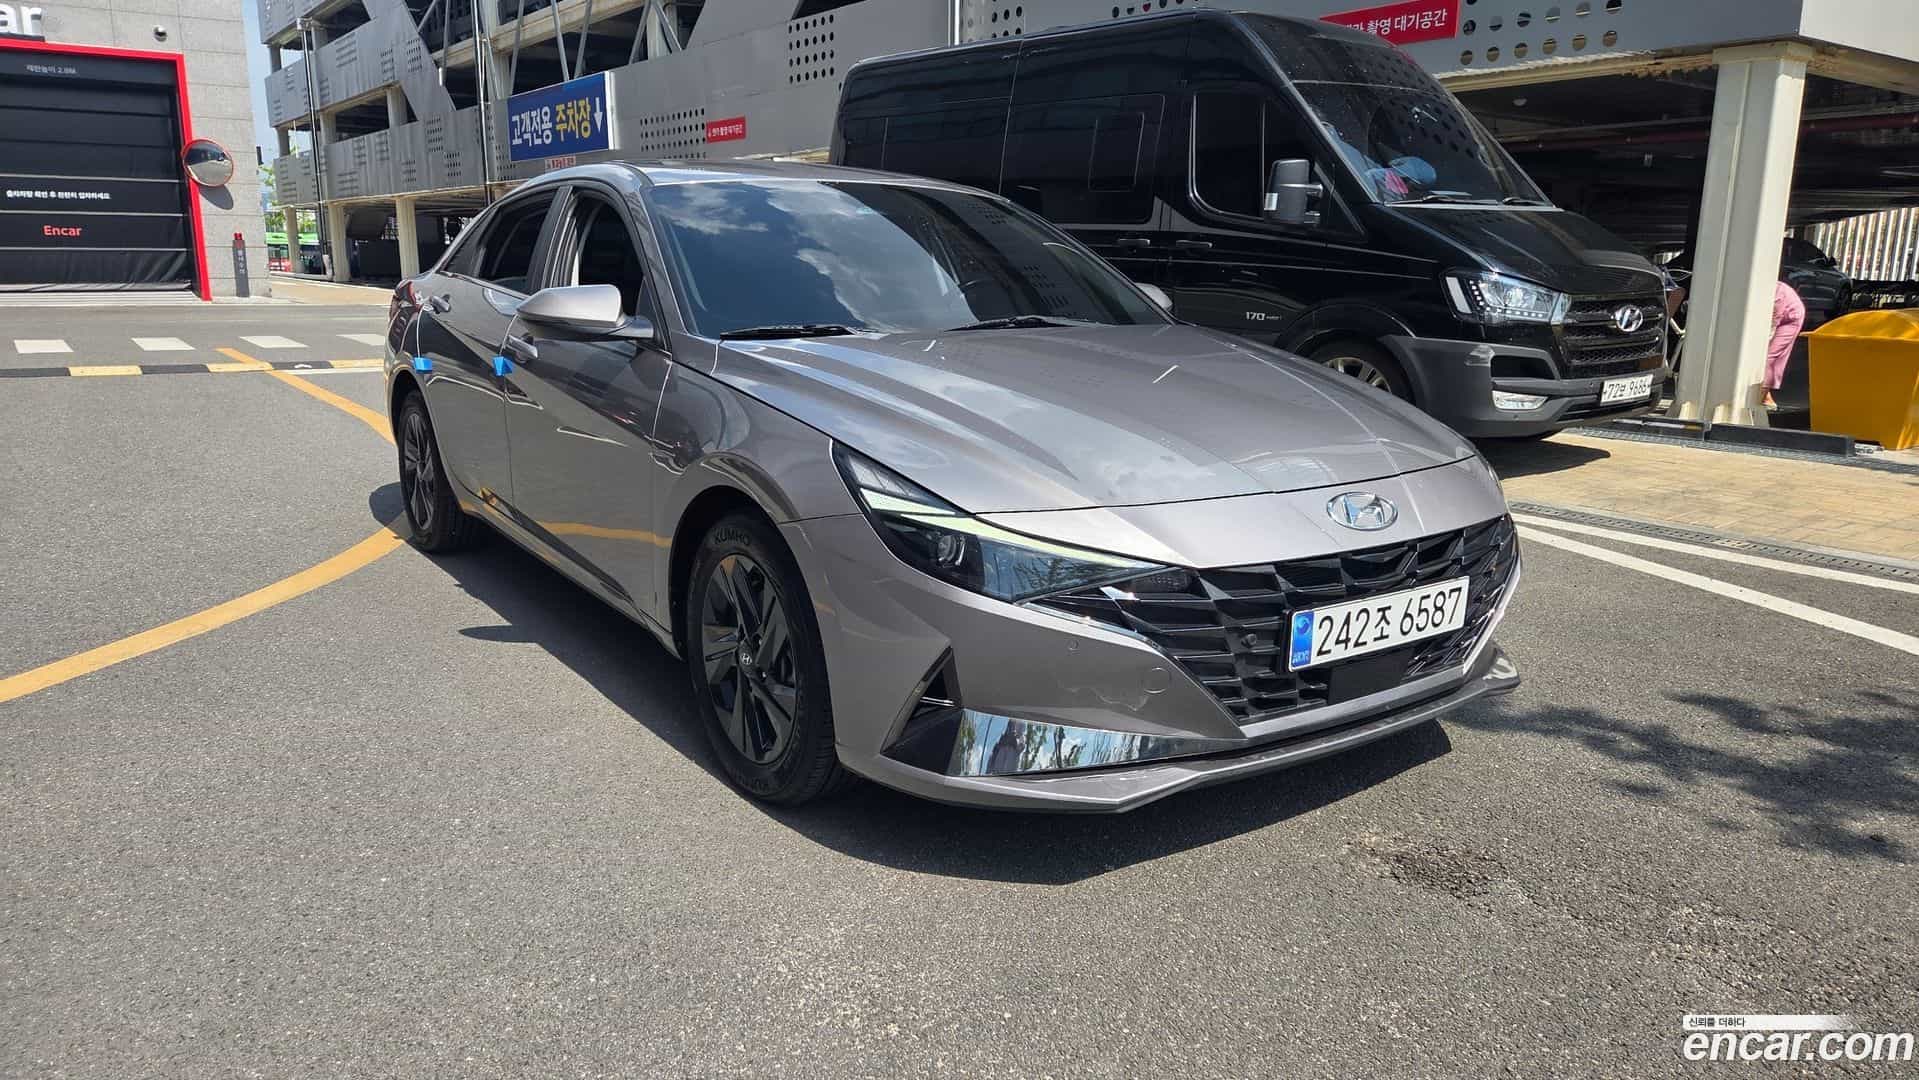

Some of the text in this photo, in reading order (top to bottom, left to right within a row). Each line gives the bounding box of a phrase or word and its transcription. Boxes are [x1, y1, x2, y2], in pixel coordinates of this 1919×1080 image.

[1394, 8, 1448, 31] 대기공간
[512, 97, 591, 147] 고객전용 주차장
[43, 225, 82, 236] Encar
[714, 528, 750, 546] KUMHO
[1316, 587, 1462, 657] 242조 6587
